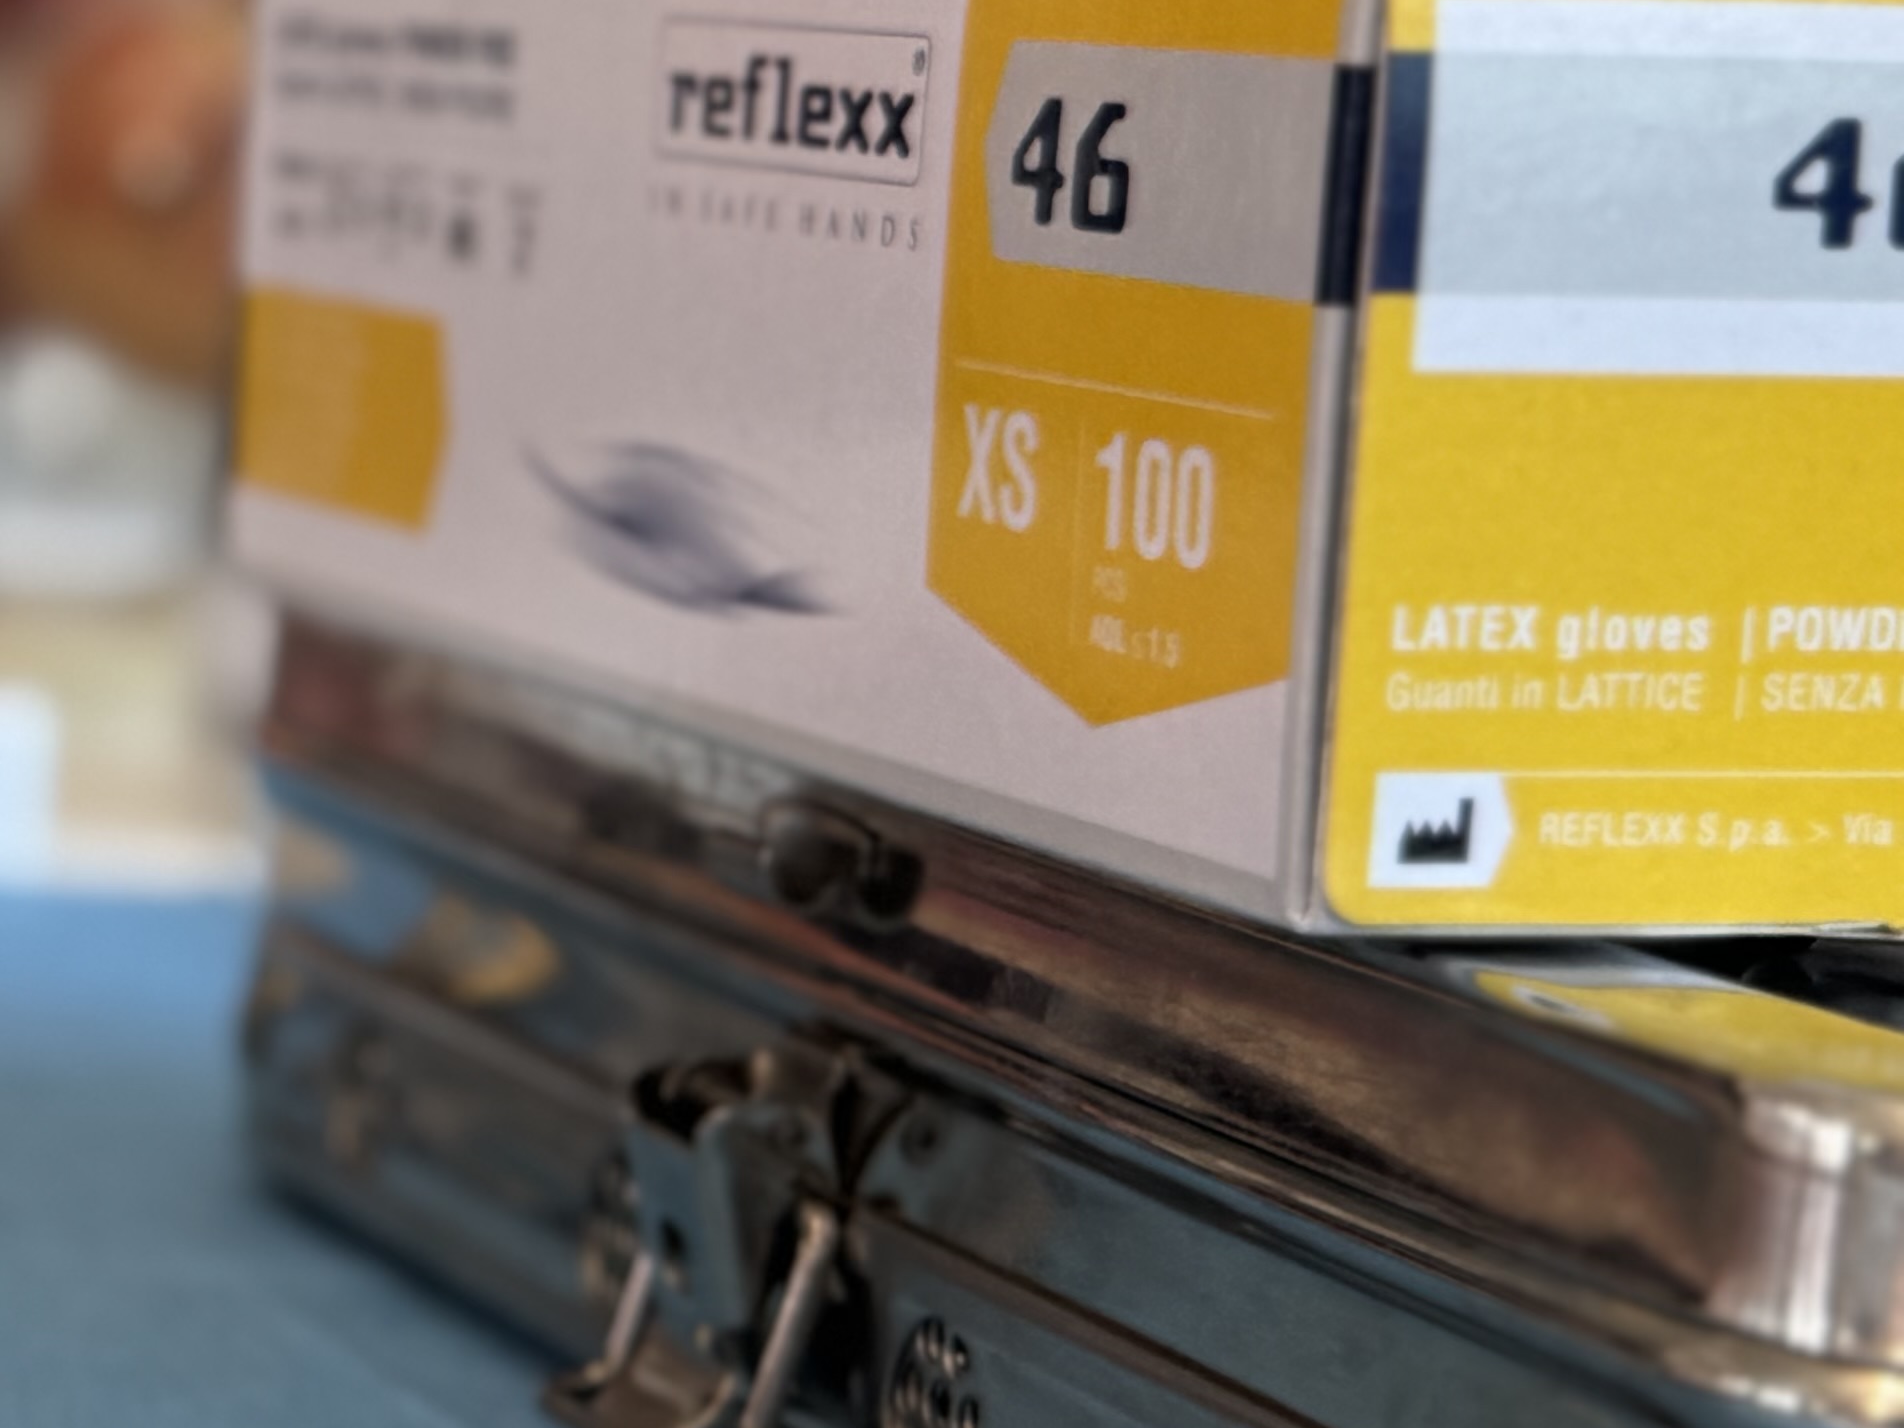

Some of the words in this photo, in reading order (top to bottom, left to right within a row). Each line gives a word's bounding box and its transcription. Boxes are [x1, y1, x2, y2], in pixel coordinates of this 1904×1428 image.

[668, 54, 915, 159] reflexx
[1011, 97, 1130, 234] 46
[1771, 116, 1904, 251] 4
[798, 201, 920, 252] HANDS
[957, 403, 1039, 533] XS
[1095, 431, 1213, 569] 100
[1391, 605, 1538, 650] LATEX
[1557, 606, 1710, 661] gloves
[1385, 671, 1498, 711] Guanti
[1511, 672, 1542, 711] in
[1557, 672, 1703, 711] LATTICE
[1761, 673, 1885, 712] SENZA
[1538, 812, 1683, 846] REFLEXX
